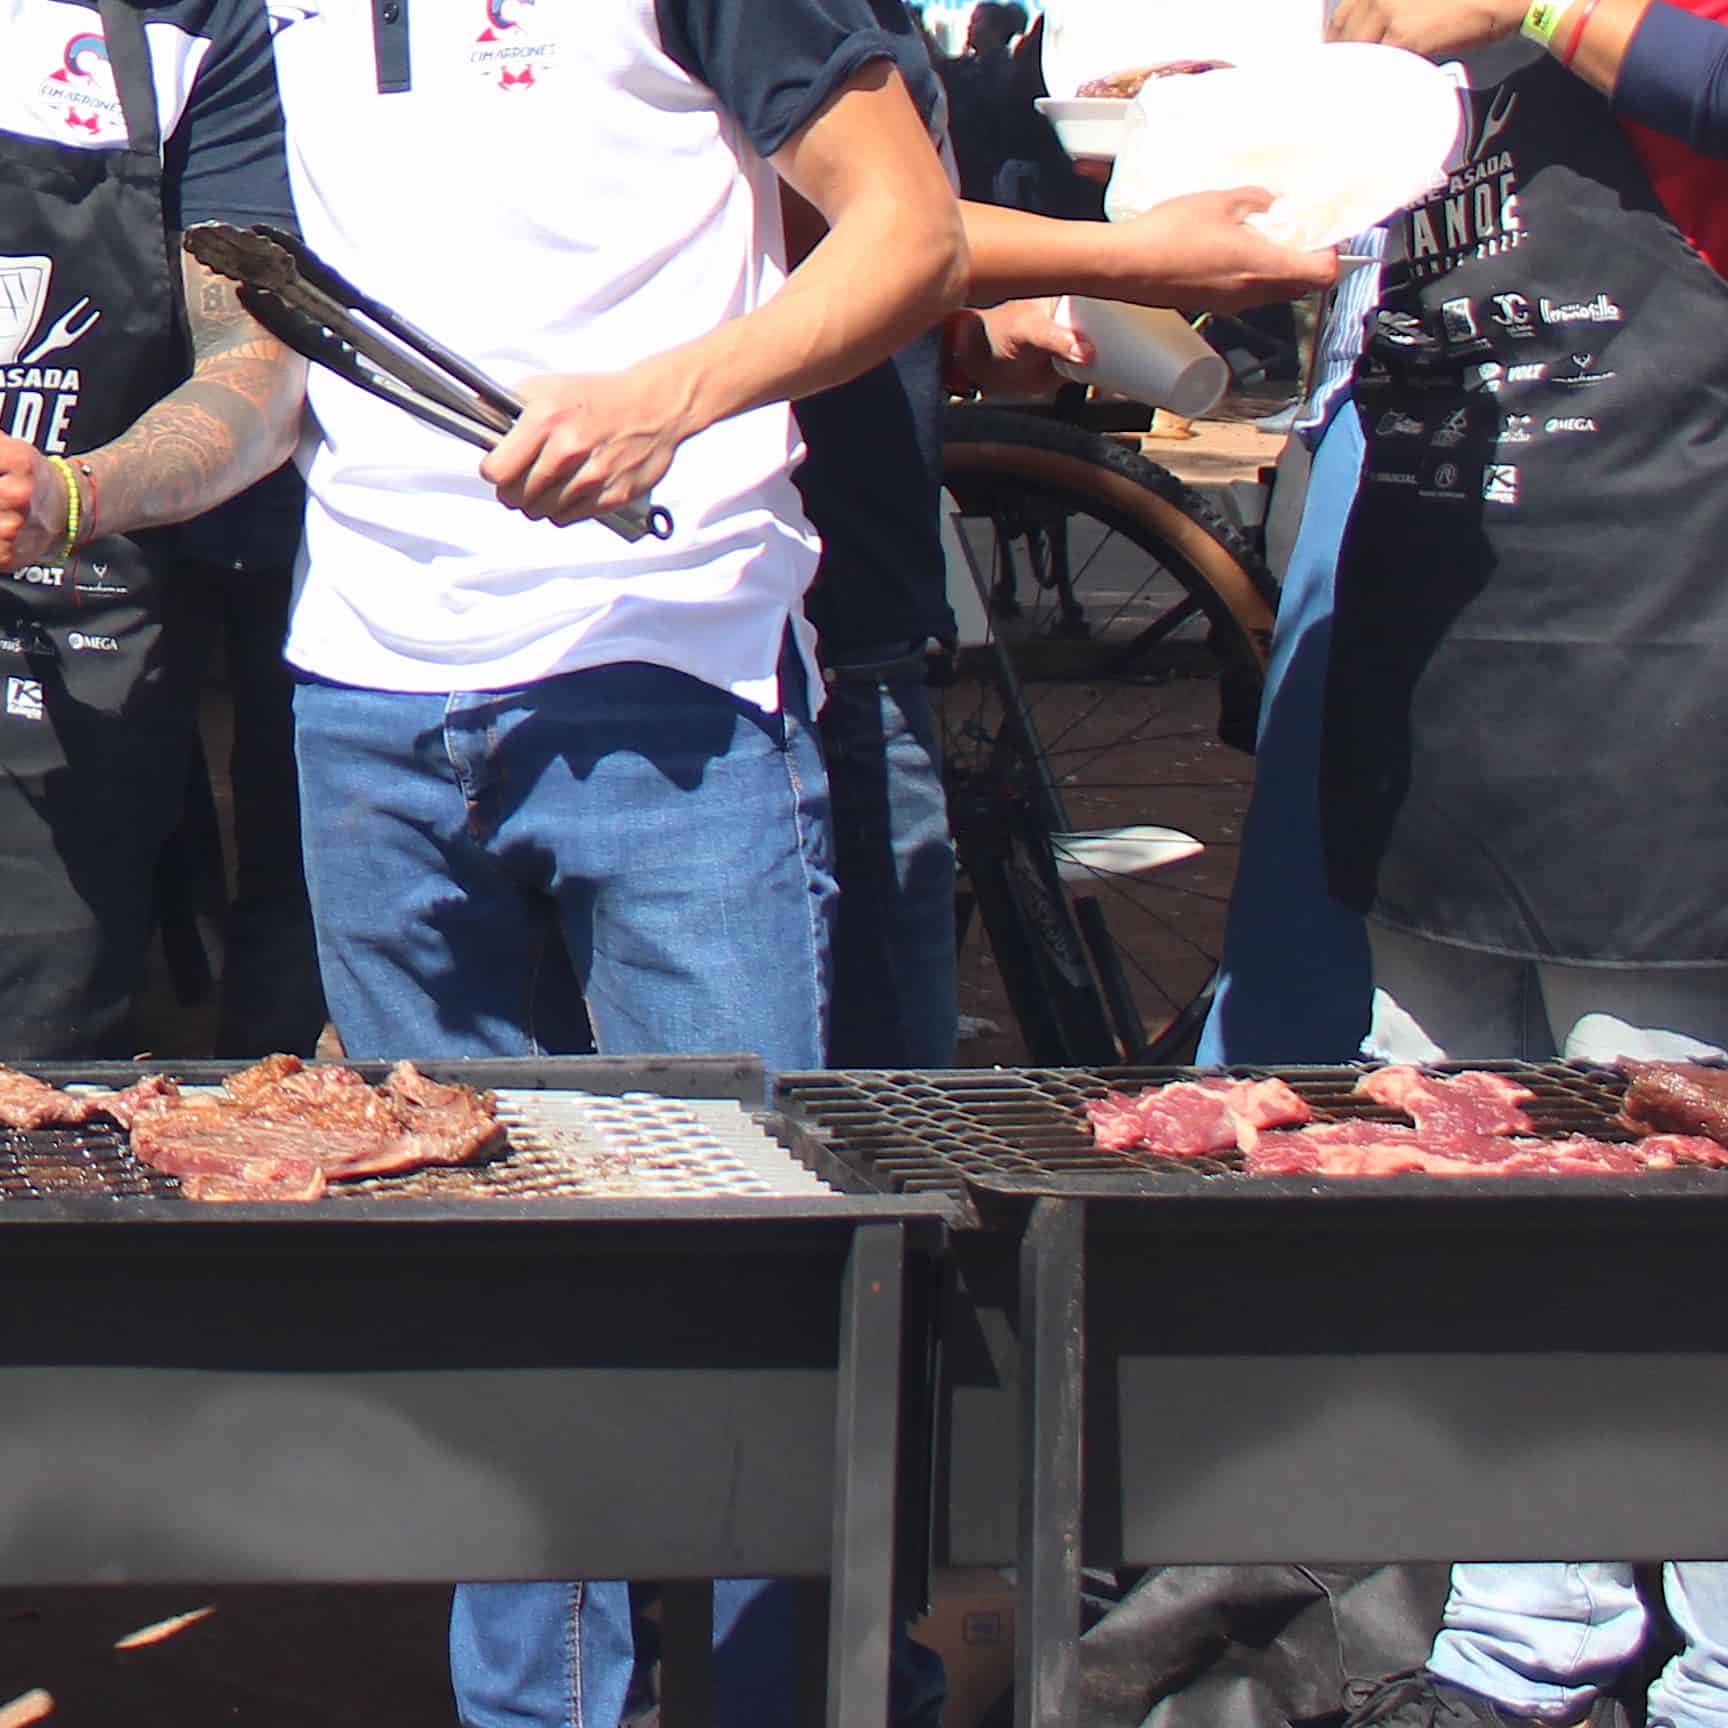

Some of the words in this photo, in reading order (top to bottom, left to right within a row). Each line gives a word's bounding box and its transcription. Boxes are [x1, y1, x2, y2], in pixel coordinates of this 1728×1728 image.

[40, 84, 120, 114] CIMARRONE
[1450, 151, 1513, 193] ASADA
[1411, 172, 1520, 258] ANDE
[68, 631, 120, 651] OMEGA
